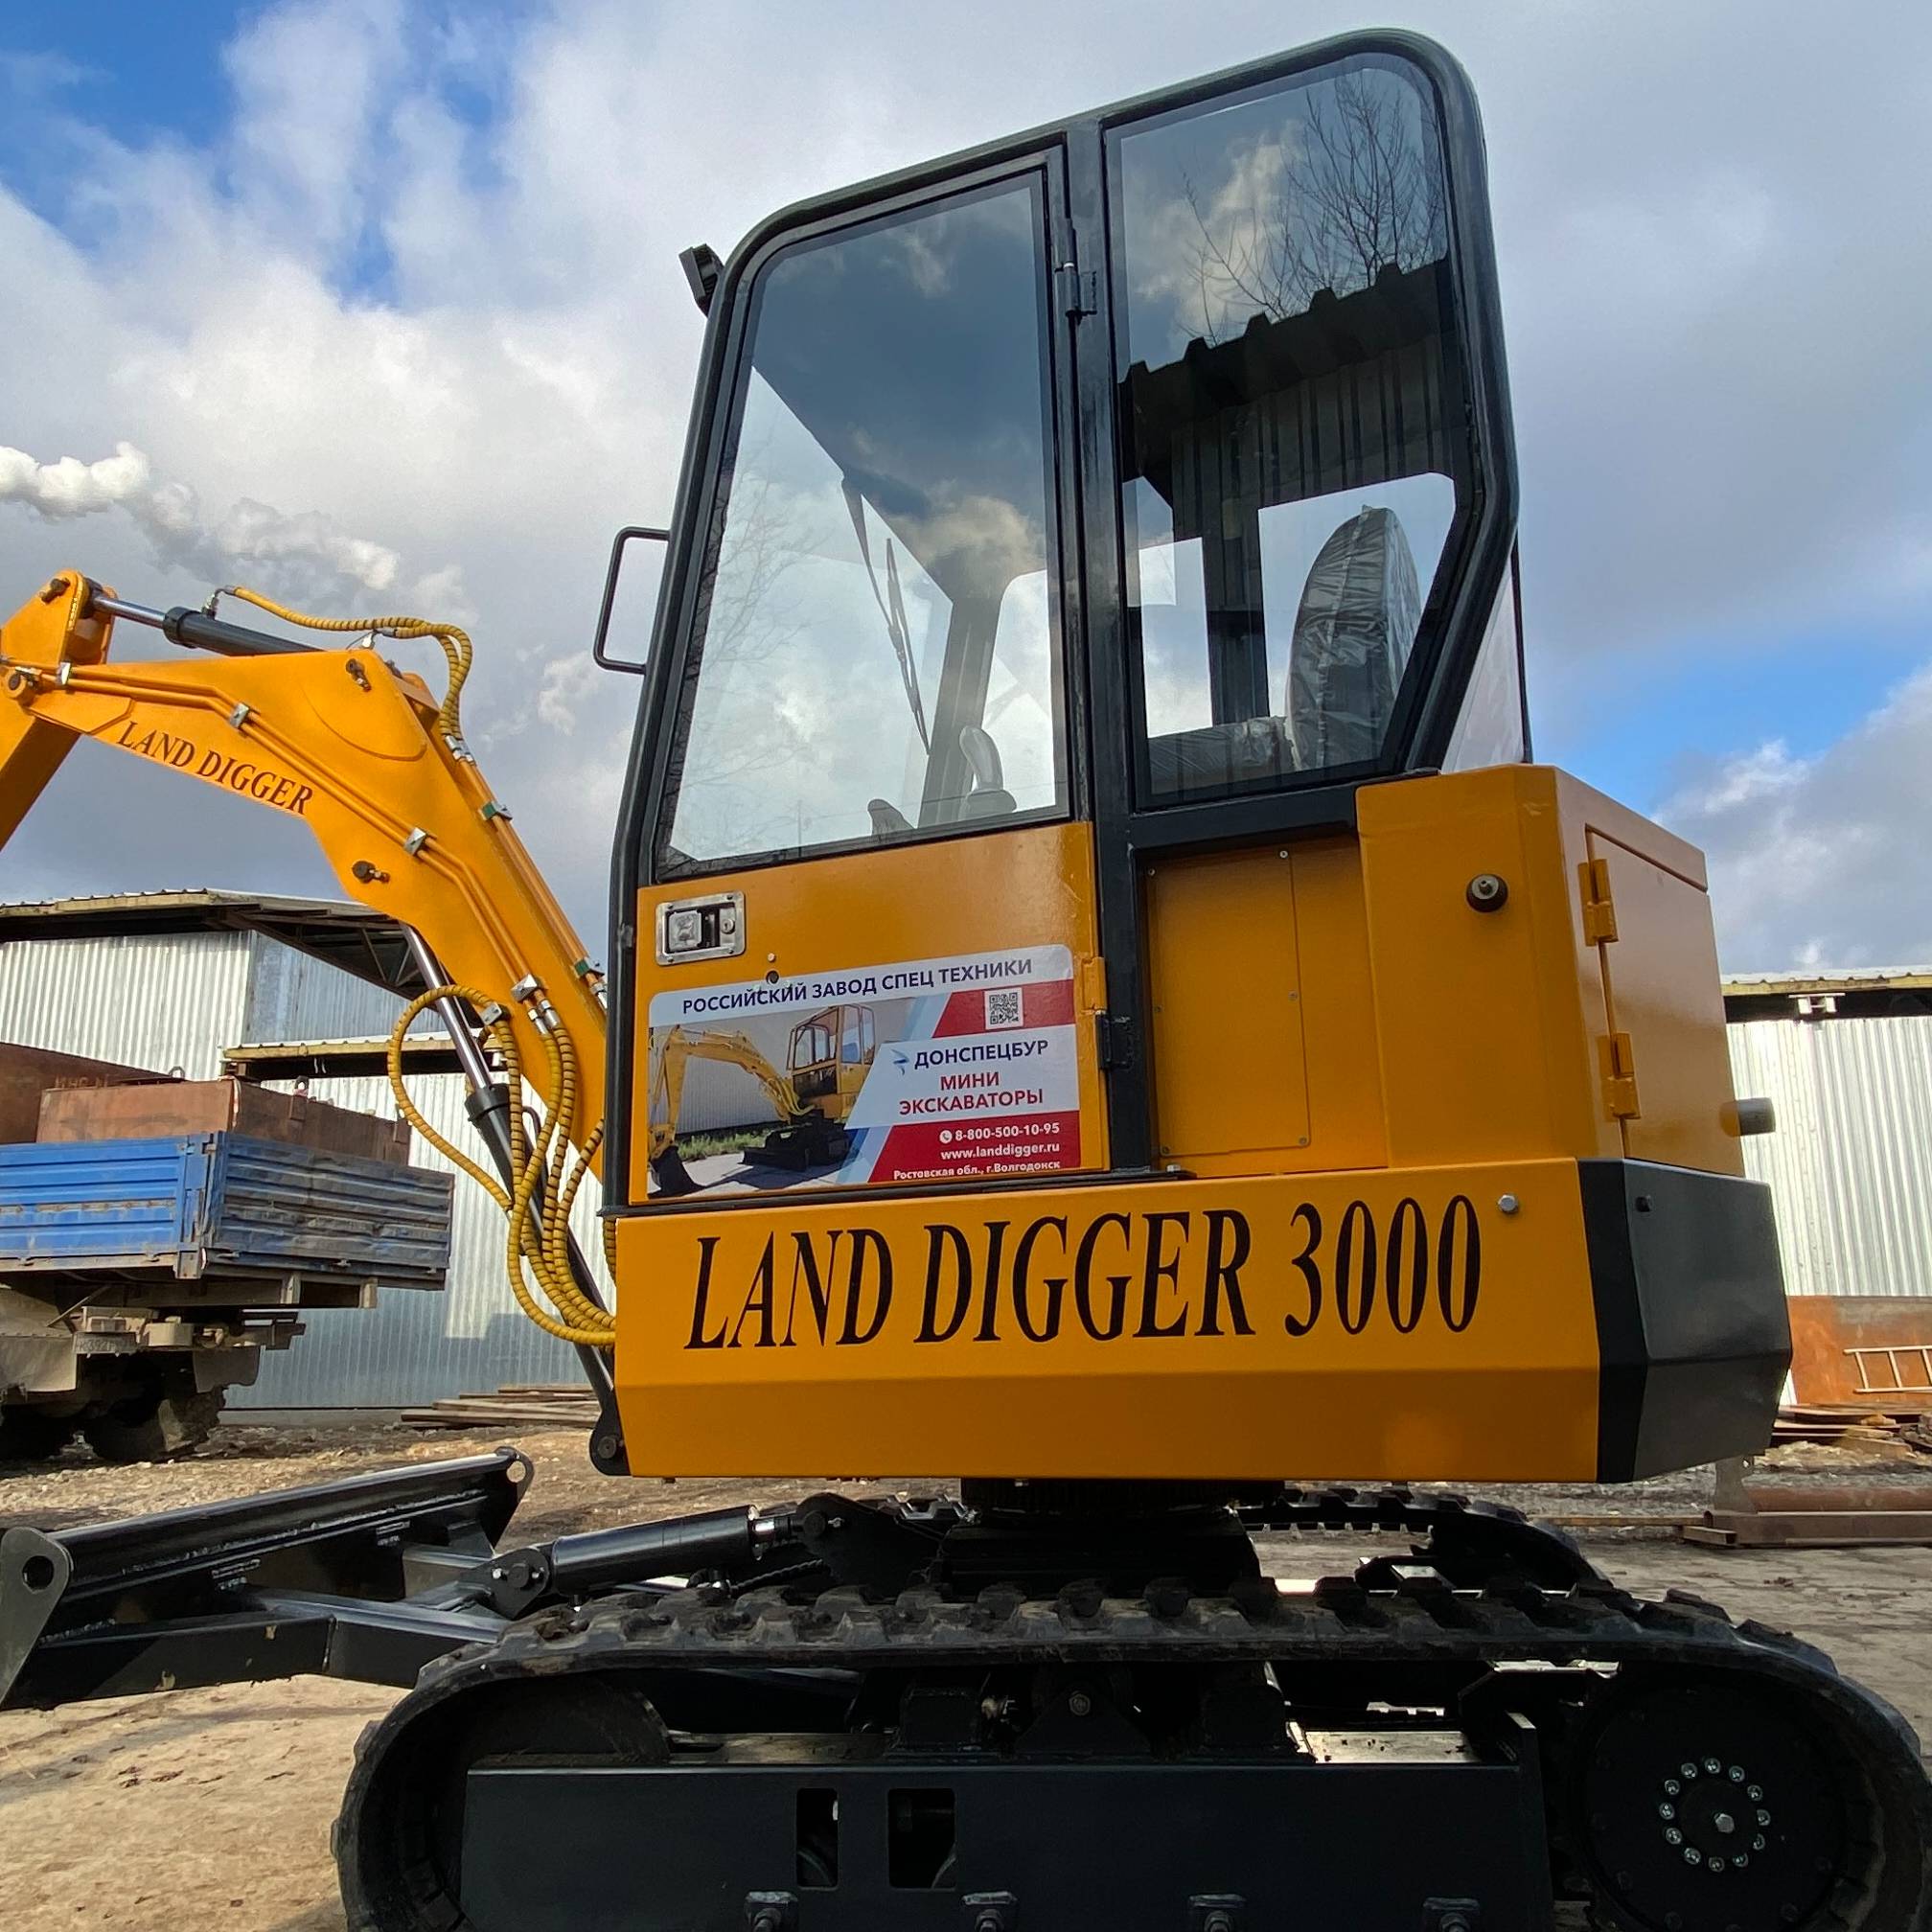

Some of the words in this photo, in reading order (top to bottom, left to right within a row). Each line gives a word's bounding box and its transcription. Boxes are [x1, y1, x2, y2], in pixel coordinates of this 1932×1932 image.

[116, 721, 196, 767] LAND
[196, 749, 313, 815] DIGGER
[682, 982, 807, 1014] РОССИЙСКИЙ
[812, 977, 877, 999] ЗАВОД
[882, 969, 933, 990] СПЕЦ
[938, 958, 1033, 984] ТЕХНИКИ
[914, 1039, 1048, 1070] ДОНСПЕЦБУР
[940, 1071, 1000, 1091] МИНИ
[899, 1089, 1044, 1116] ЭКСКАВАТОРЫ
[954, 1122, 1061, 1141] 8-800-500-10-95
[940, 1142, 1061, 1161] www.landdigger.ru
[893, 1168, 955, 1181] Ростовская
[684, 1228, 892, 1349] LAND
[913, 1210, 1256, 1344] DIGGER
[1284, 1194, 1482, 1338] 3000
